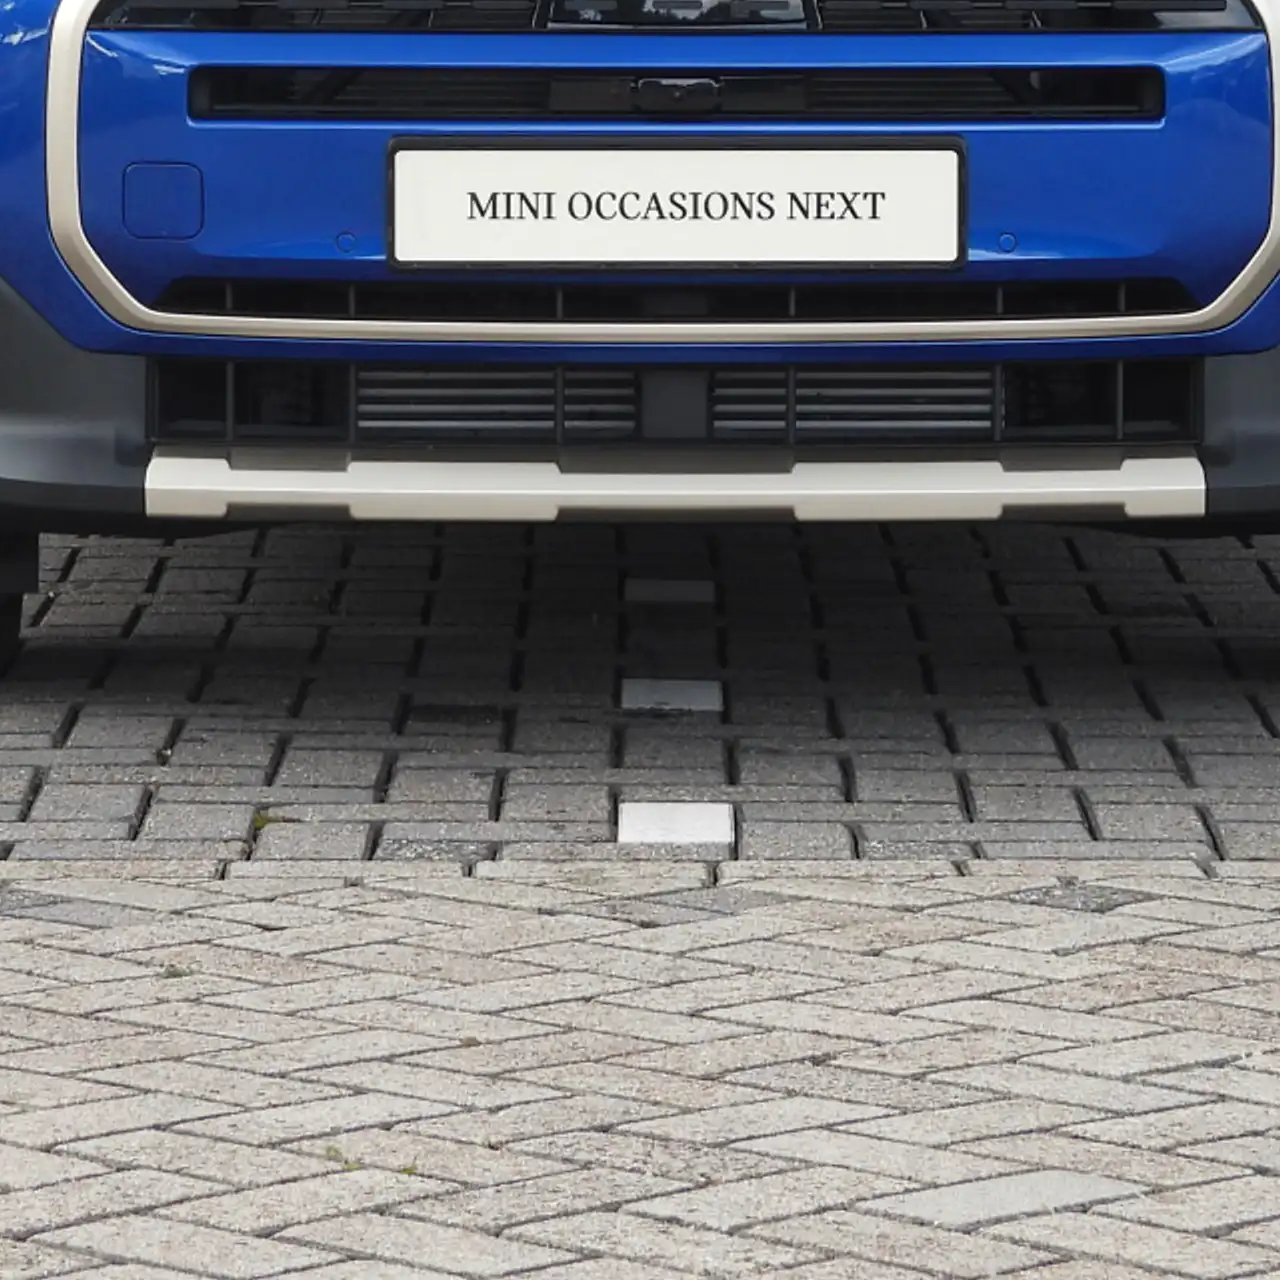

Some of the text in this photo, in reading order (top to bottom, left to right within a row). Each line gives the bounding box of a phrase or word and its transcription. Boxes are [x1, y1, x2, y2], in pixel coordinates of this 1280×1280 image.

[466, 191, 887, 221] MINI OCCASIONS NEXT
